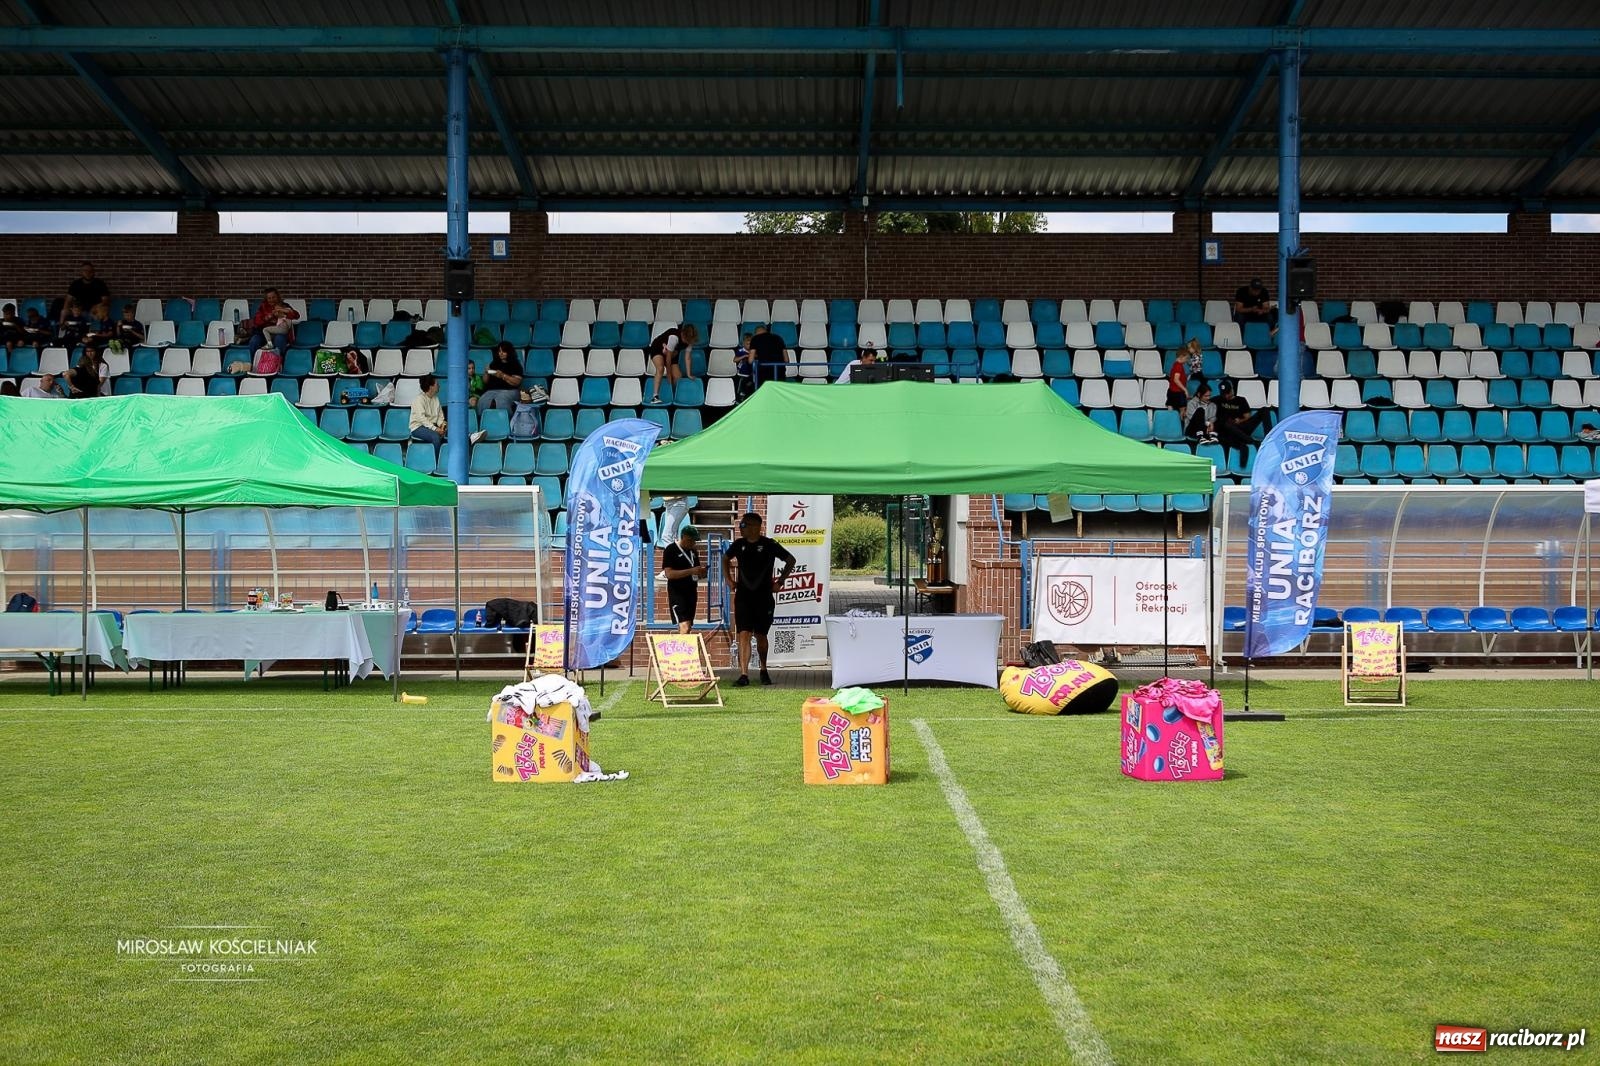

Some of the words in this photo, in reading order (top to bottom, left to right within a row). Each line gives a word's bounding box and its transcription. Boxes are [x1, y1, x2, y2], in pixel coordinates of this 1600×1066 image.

[601, 461, 634, 477] UNIA
[1285, 454, 1319, 471] UNIA
[575, 498, 587, 556] SPORTOWY
[774, 524, 807, 534] BRICO
[1257, 492, 1269, 548] SPORTOWY
[572, 559, 581, 587] KLUB
[585, 525, 612, 609] UNIA
[610, 502, 636, 635] RACIBÓRZ
[777, 564, 807, 576] NSZE
[1255, 552, 1264, 578] KLUB
[1267, 519, 1297, 600] UNIA
[1294, 495, 1322, 626] RACIBÓRZ
[775, 575, 813, 590] ENY
[570, 590, 580, 633] MIEJSKI
[1252, 582, 1262, 623] MIEJSKI
[1049, 684, 1075, 707] FOR
[1071, 671, 1096, 688] FUN
[850, 729, 860, 760] HOME
[859, 727, 872, 762] PETS
